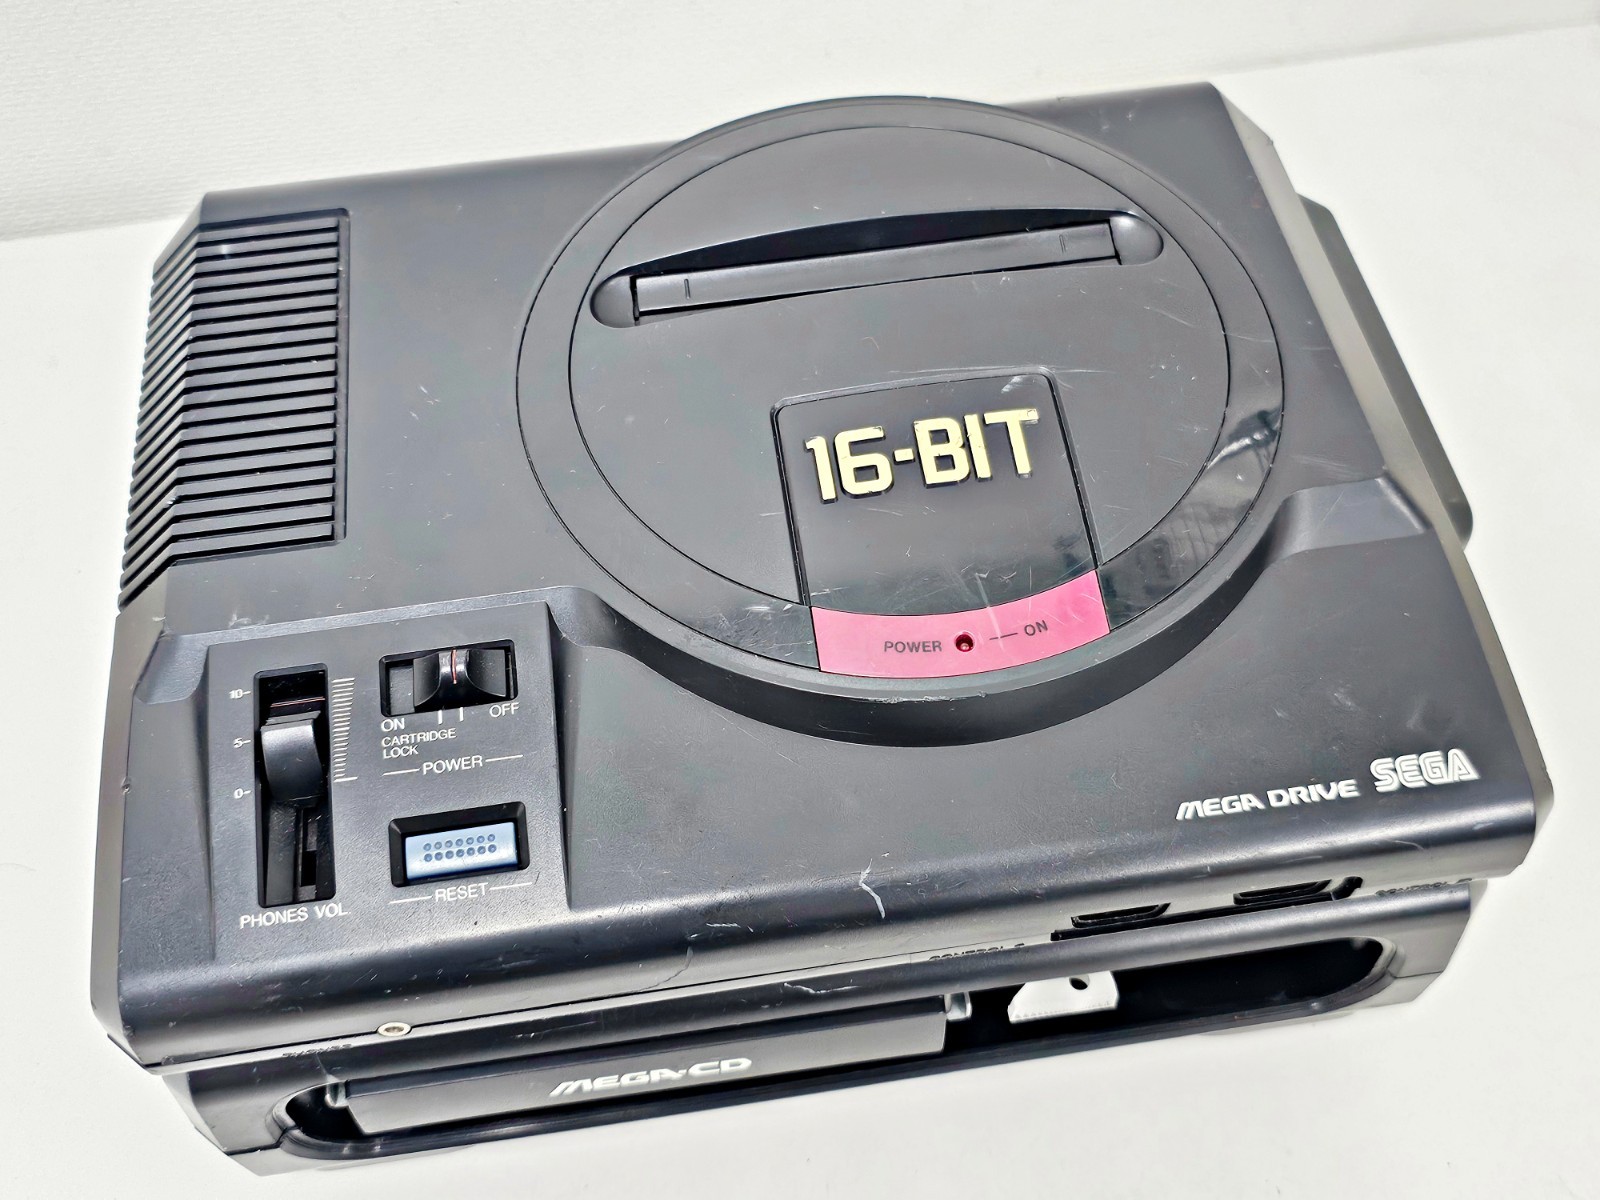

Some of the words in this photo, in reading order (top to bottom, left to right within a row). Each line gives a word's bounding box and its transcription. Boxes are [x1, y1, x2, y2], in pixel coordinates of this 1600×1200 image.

[805, 408, 1040, 504] 16-BIT
[884, 639, 943, 655] POWER
[1023, 619, 1048, 638] ON
[489, 702, 519, 718] OFF
[381, 718, 405, 732] ON
[381, 728, 456, 747] CARTRIDGE
[382, 745, 418, 759] LOCK
[422, 755, 483, 776] POWER
[1370, 748, 1480, 792] SEGA
[1175, 793, 1265, 820] MEGA
[1267, 779, 1360, 807] DRIVE
[434, 882, 488, 902] RESET
[239, 908, 308, 929] PHONES
